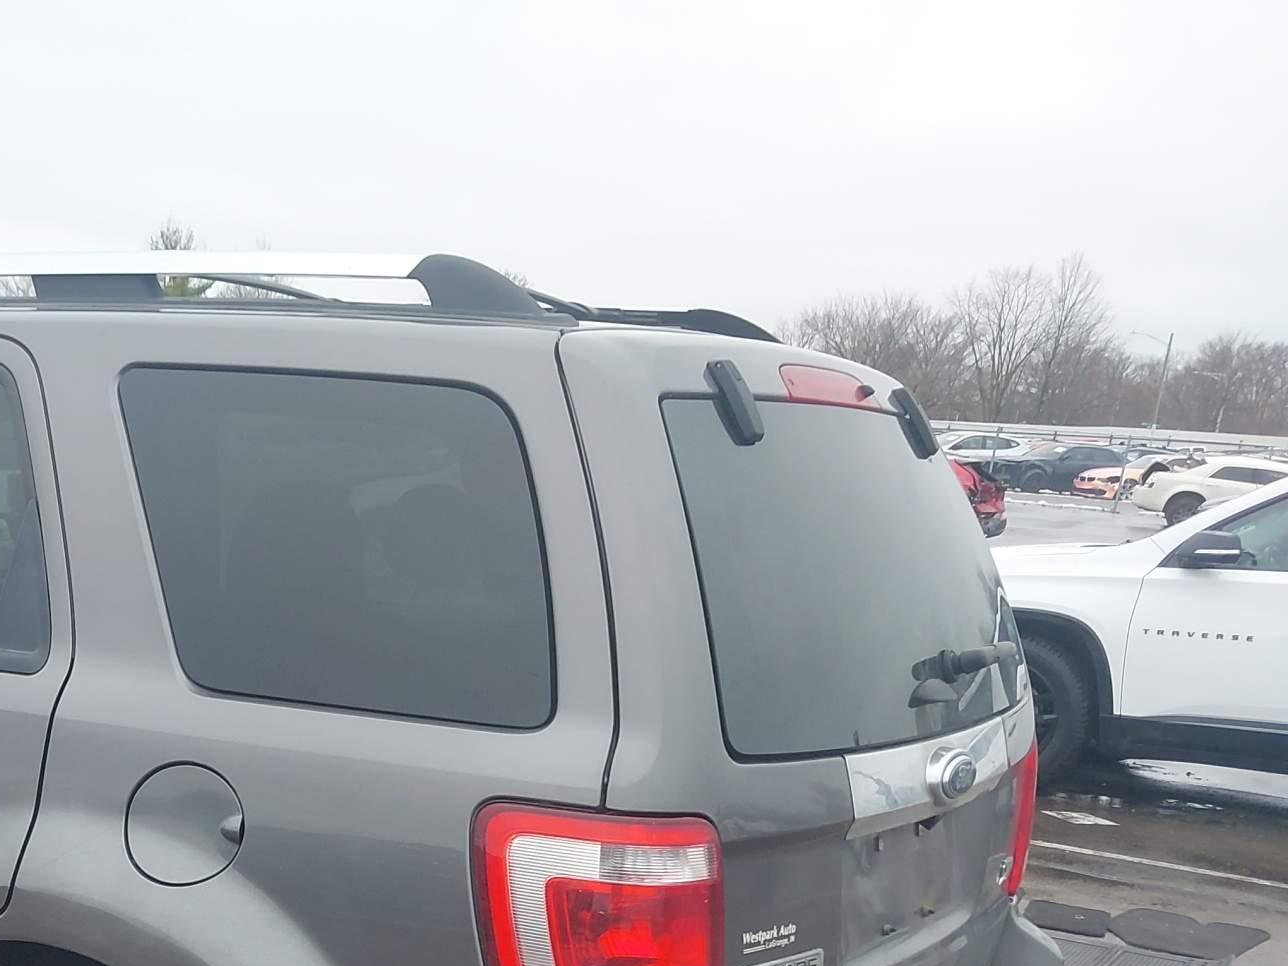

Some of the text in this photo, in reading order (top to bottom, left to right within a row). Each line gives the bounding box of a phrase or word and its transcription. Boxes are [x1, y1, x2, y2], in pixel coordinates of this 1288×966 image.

[1143, 628, 1255, 642] TRAVERSE
[742, 925, 778, 945] Westpark
[778, 923, 797, 937] Auto
